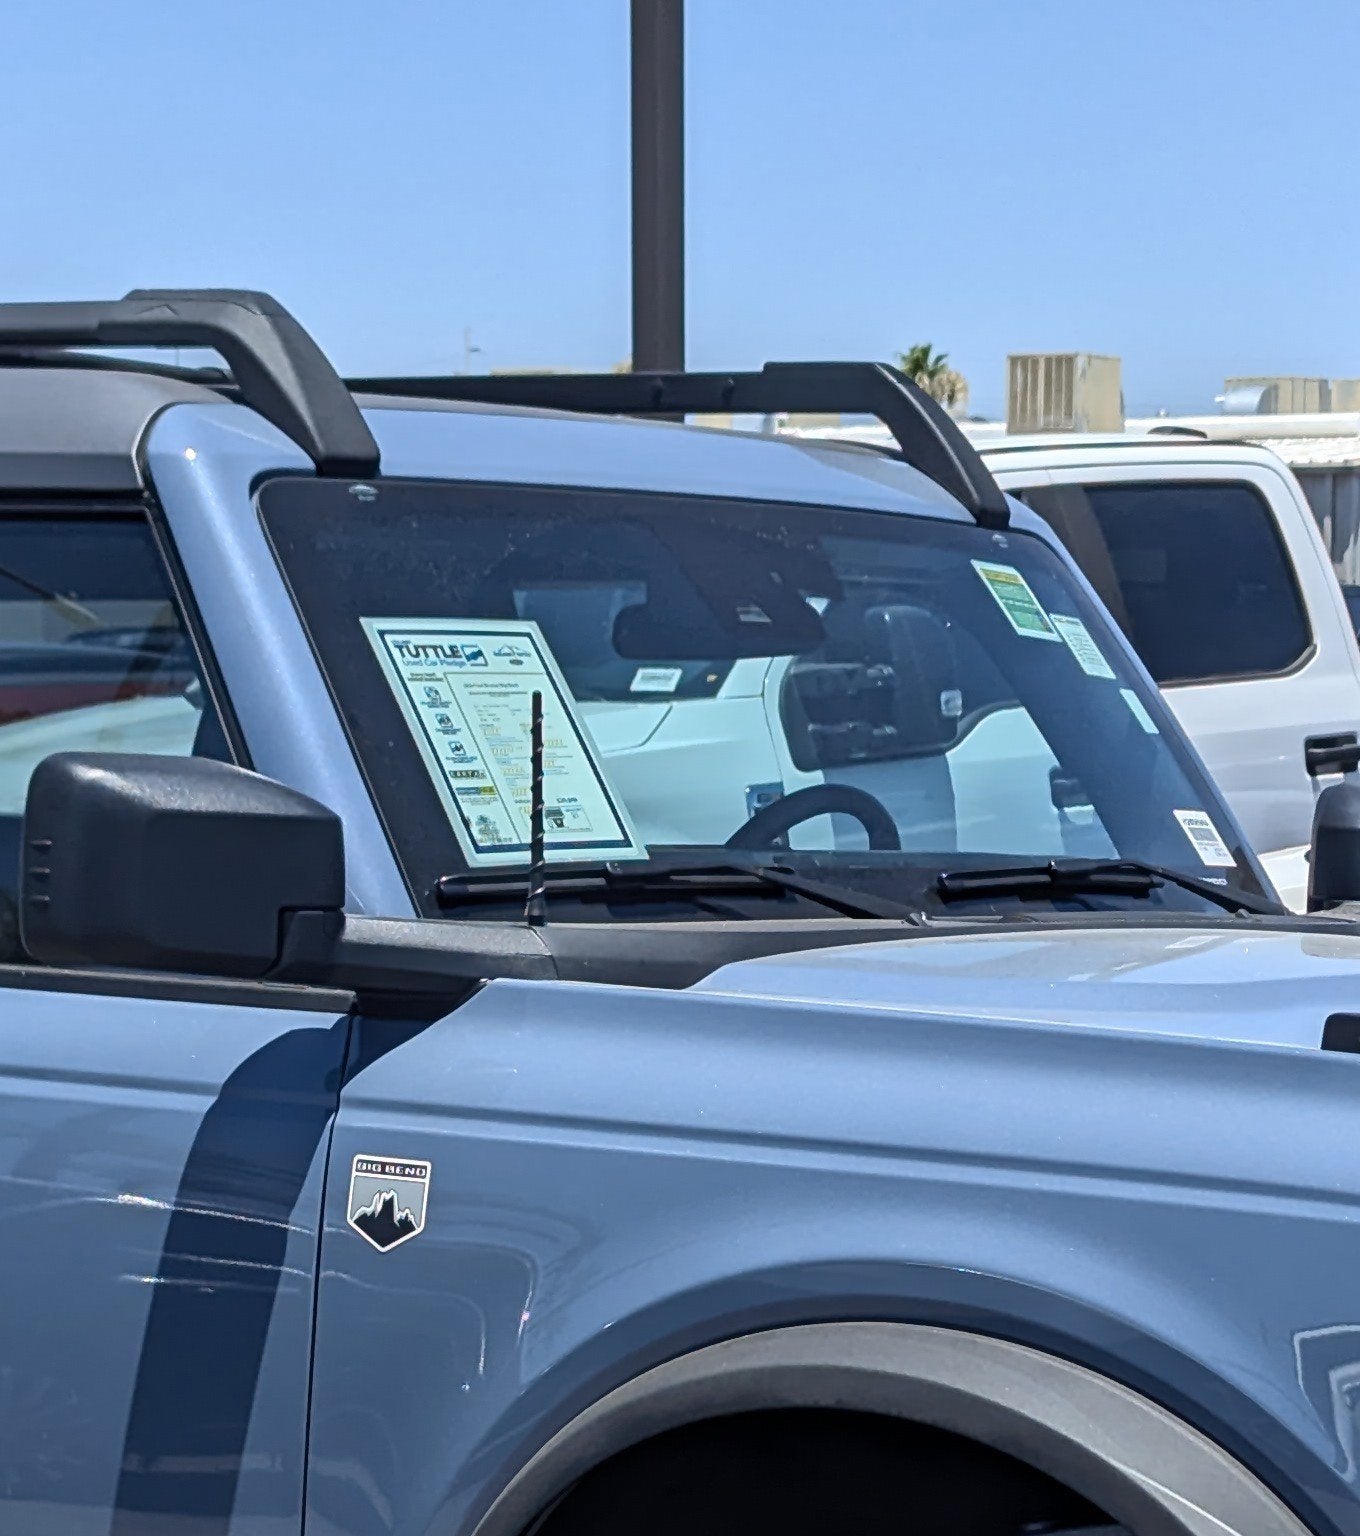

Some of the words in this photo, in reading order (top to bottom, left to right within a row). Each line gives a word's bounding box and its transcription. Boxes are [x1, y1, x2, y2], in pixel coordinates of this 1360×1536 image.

[394, 644, 463, 659] TUTTLE
[357, 1161, 382, 1173] BIG
[385, 1164, 426, 1176] BEND
